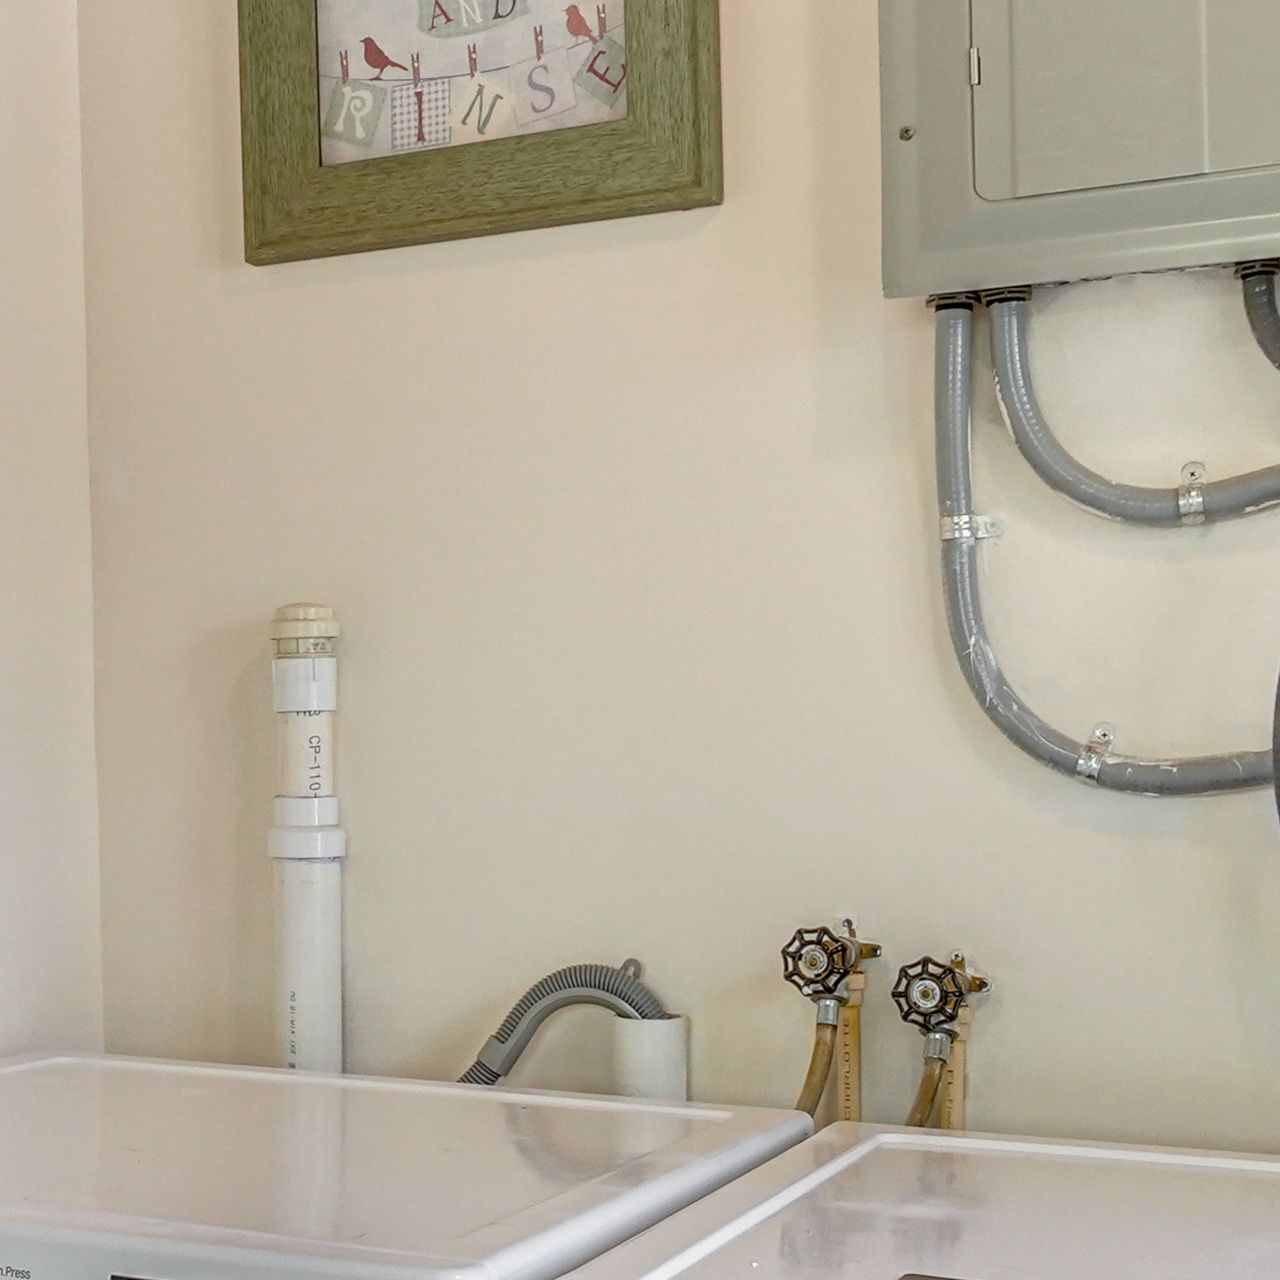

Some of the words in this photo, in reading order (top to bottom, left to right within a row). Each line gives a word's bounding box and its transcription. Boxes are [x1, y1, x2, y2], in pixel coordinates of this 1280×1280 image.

[428, 0, 517, 31] AND
[334, 49, 626, 144] RINSE
[843, 1017, 851, 1121] CHARLOTTE
